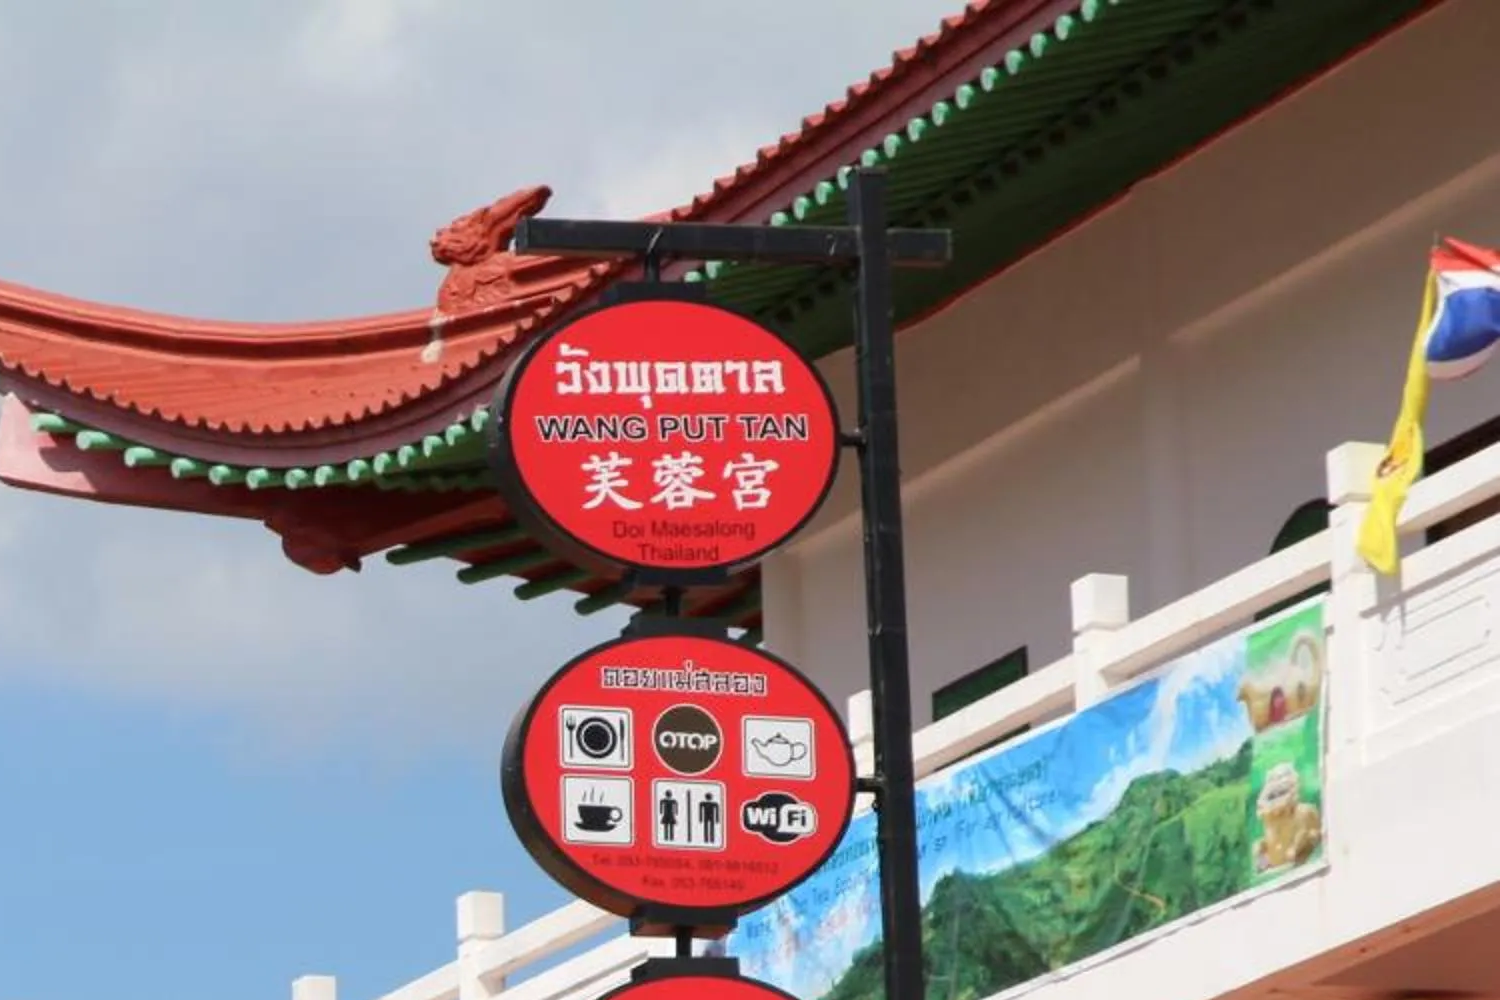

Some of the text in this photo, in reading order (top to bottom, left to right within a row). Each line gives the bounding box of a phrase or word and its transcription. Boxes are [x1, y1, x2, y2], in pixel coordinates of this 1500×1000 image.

[535, 414, 809, 443] WANG PUT TAN
[612, 520, 645, 539] Doi
[637, 543, 720, 561] Thailand
[658, 731, 718, 750] OTOP
